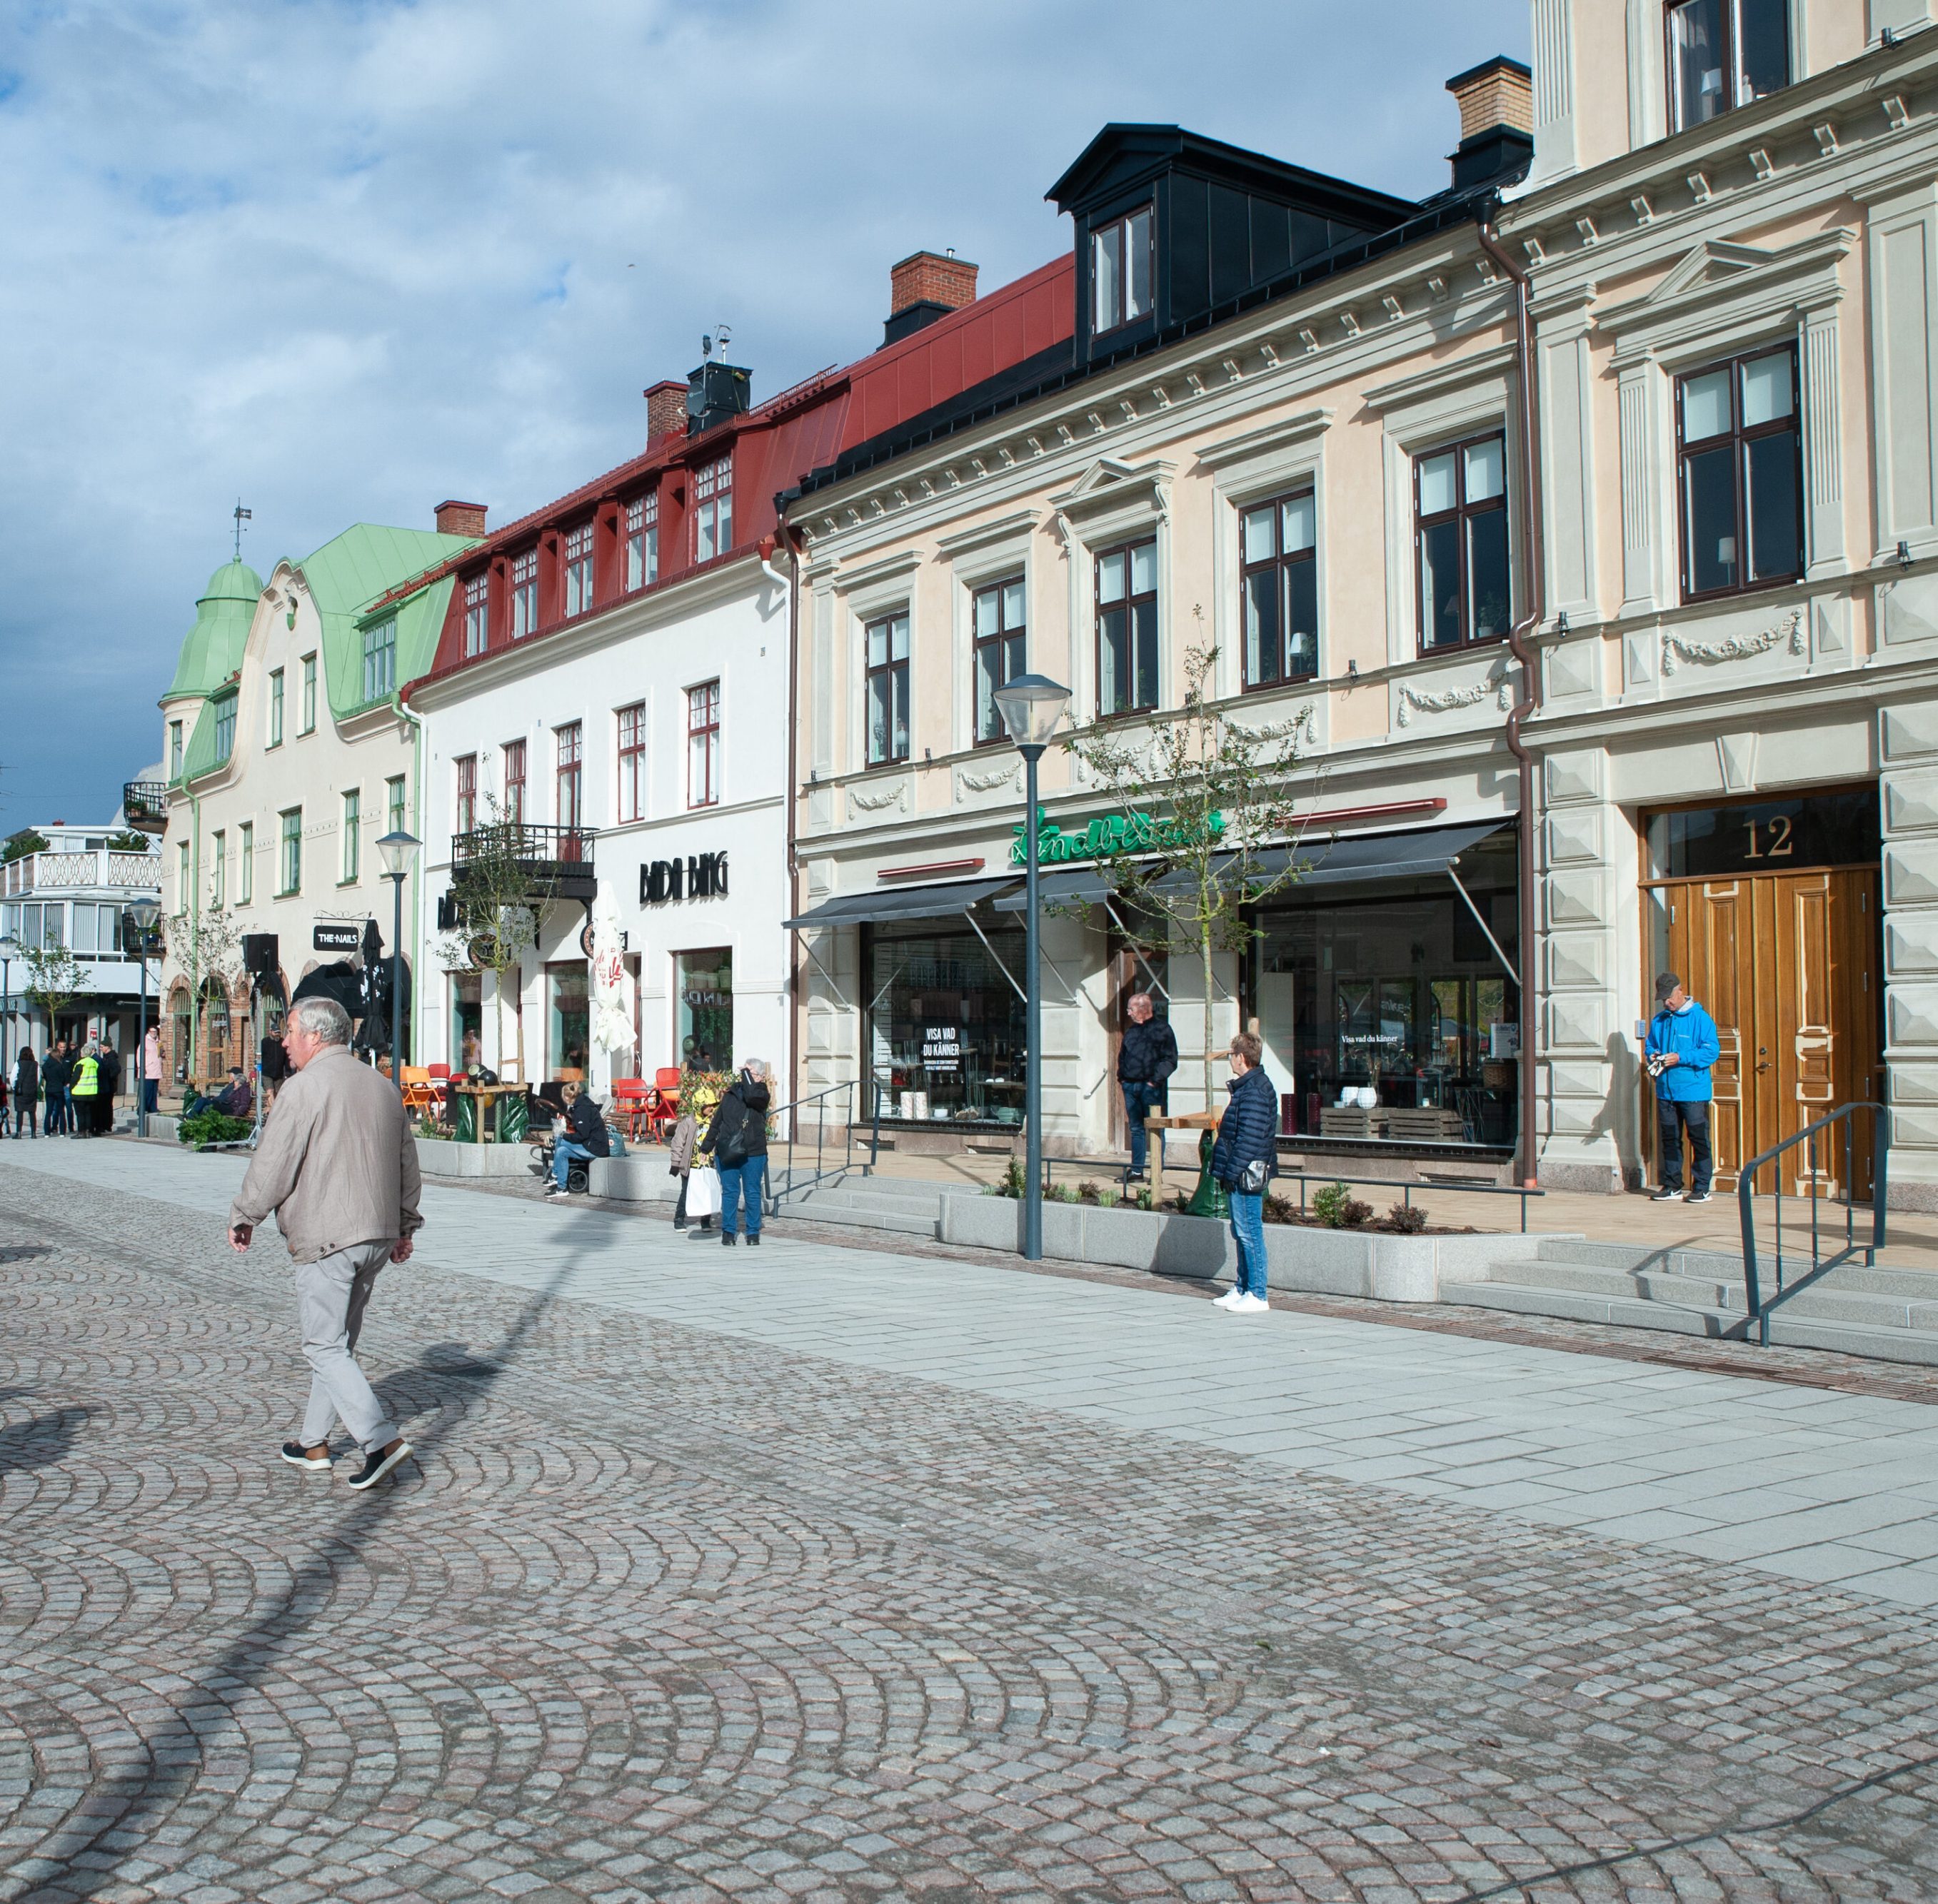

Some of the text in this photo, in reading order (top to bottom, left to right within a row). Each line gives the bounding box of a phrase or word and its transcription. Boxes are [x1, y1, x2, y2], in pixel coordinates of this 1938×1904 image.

[1743, 817, 1792, 857] 12
[688, 850, 728, 898] BING
[926, 1027, 955, 1040] VISA VAD
[1342, 1034, 1355, 1043] Visa
[1377, 1034, 1397, 1042] känner
[923, 1042, 959, 1057] DU KÄNNER
